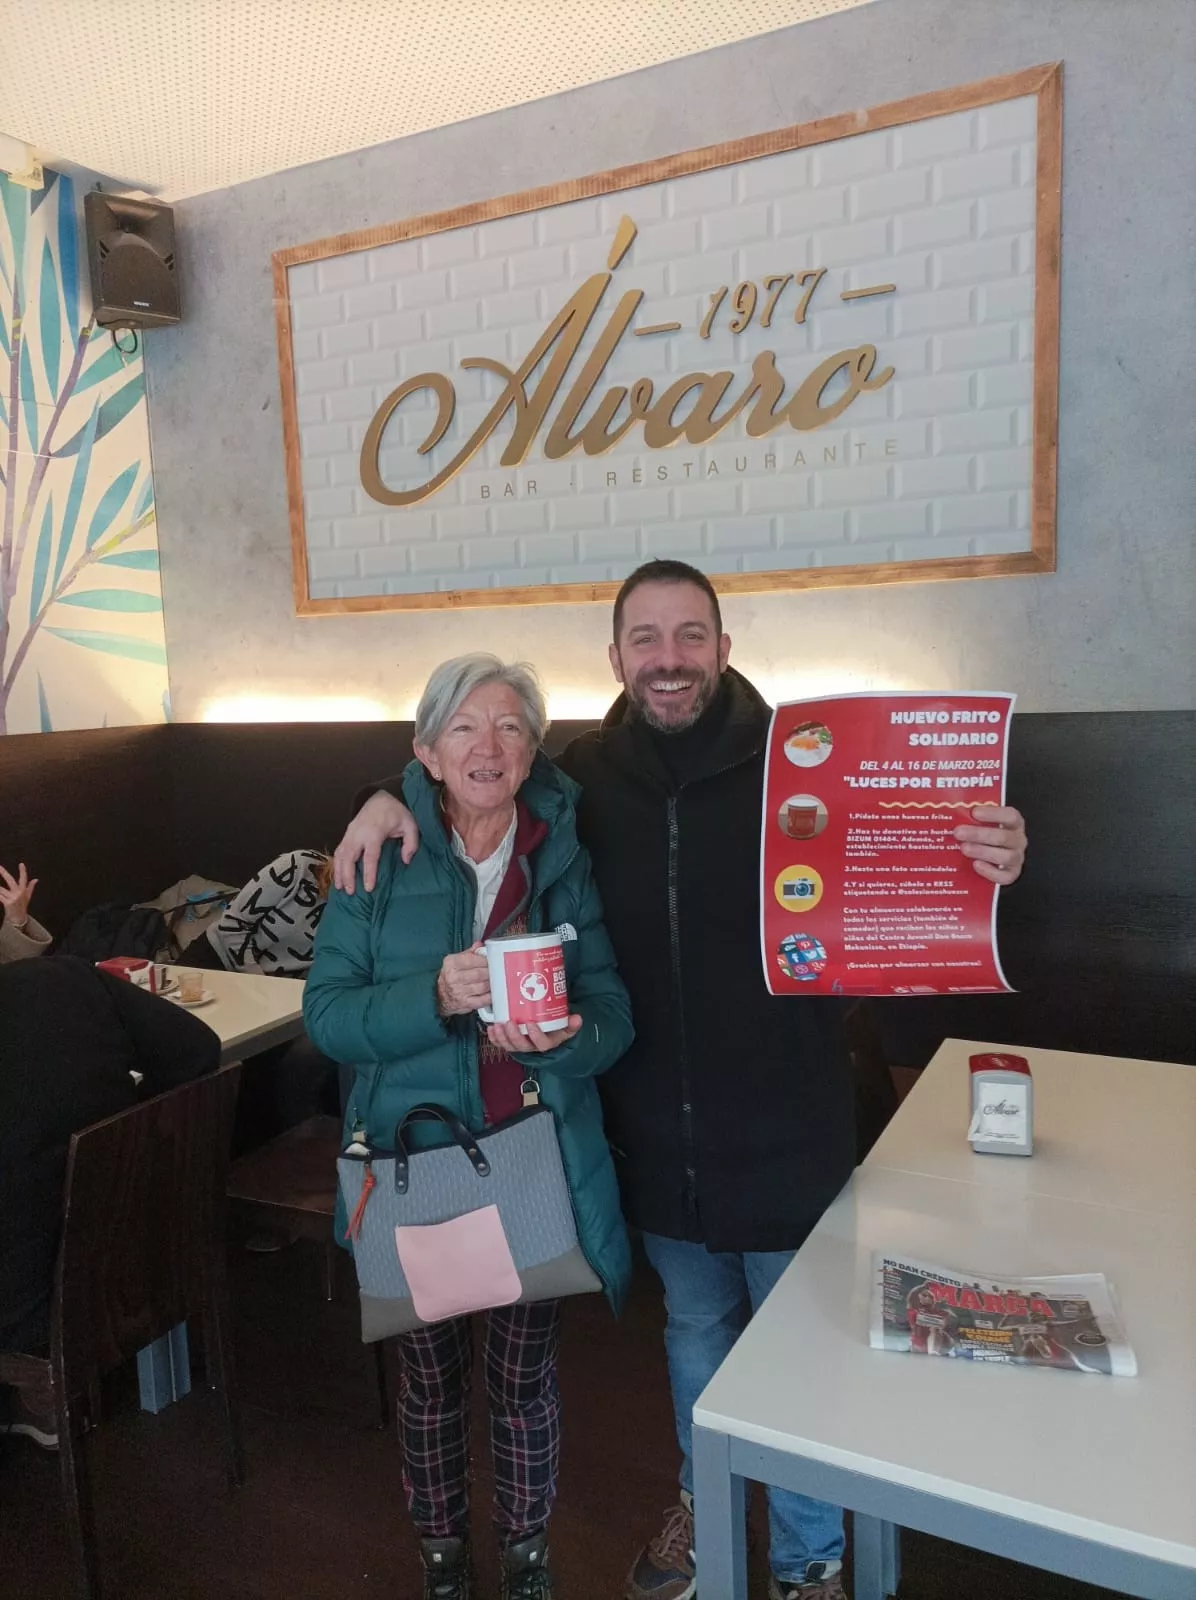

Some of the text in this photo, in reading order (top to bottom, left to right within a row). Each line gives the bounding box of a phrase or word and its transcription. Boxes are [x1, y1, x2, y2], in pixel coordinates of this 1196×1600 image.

[699, 267, 828, 339] 1977
[360, 214, 896, 507] Álvaro
[480, 437, 900, 500] BAR RESTAURANTE
[890, 711, 1001, 724] HUEVO FRITO
[909, 733, 999, 746] SOLIDARIO
[860, 759, 1001, 770] DEL 4 AL 16 DE MARZO 2024
[844, 776, 897, 788] "LUCES
[899, 776, 931, 788] POR
[883, 1259, 897, 1267] NO
[898, 1263, 919, 1274] DAN
[929, 1280, 1057, 1318] MARCA
